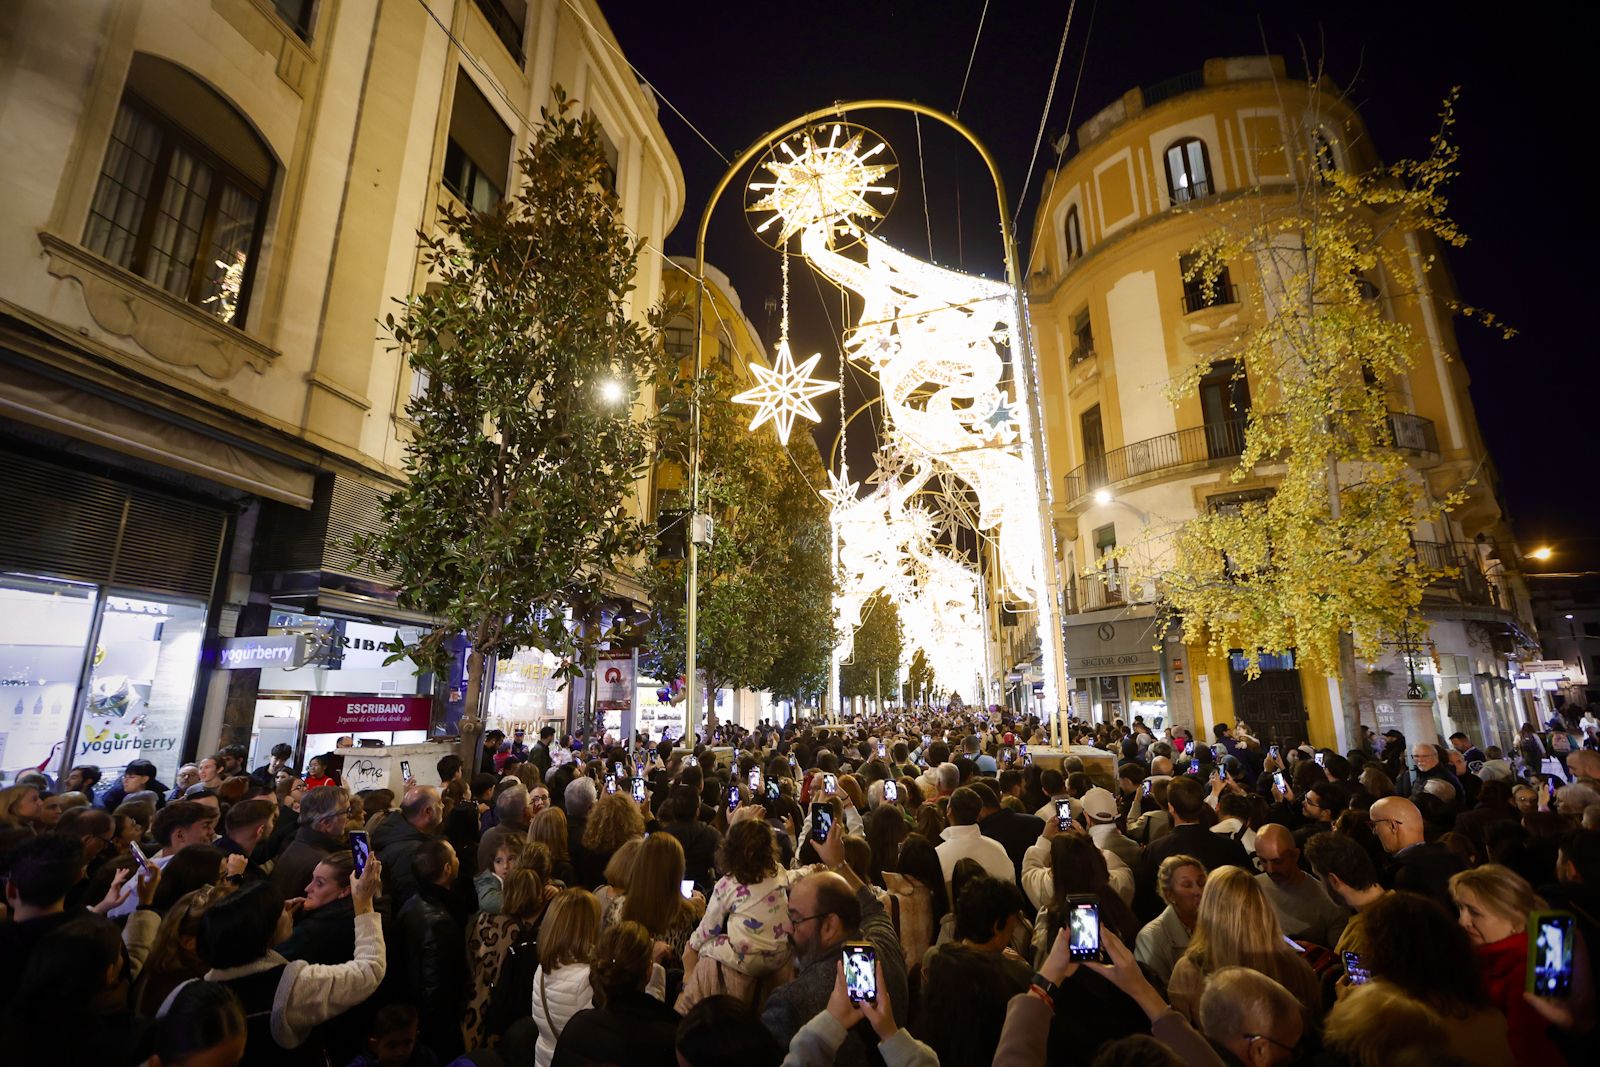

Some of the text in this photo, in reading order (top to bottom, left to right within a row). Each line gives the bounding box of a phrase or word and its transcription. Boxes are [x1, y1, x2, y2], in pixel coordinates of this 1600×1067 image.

[221, 643, 293, 664] yogurberry
[1081, 655, 1138, 666] SECTOR ORO
[347, 704, 405, 714] ESCRIBANO
[81, 735, 176, 755] yogurberry
